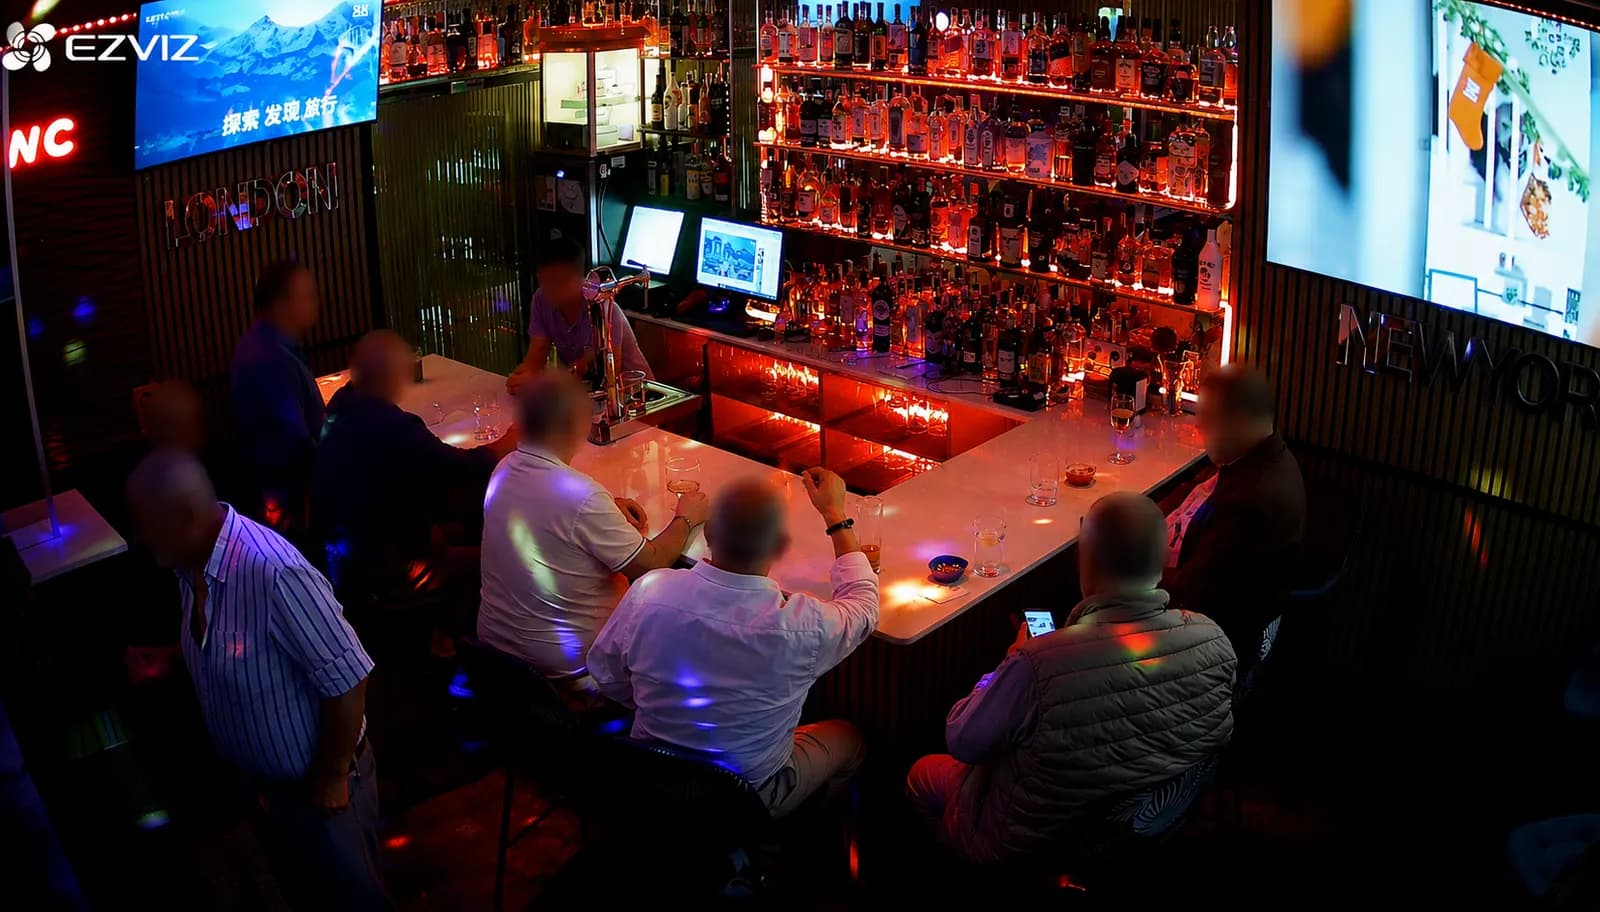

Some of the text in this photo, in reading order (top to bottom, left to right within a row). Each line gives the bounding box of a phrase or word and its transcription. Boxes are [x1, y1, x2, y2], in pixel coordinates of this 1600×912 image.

[222, 95, 338, 136] 探索 发现 旅行
[9, 118, 74, 168] NC
[164, 162, 339, 250] LONDON
